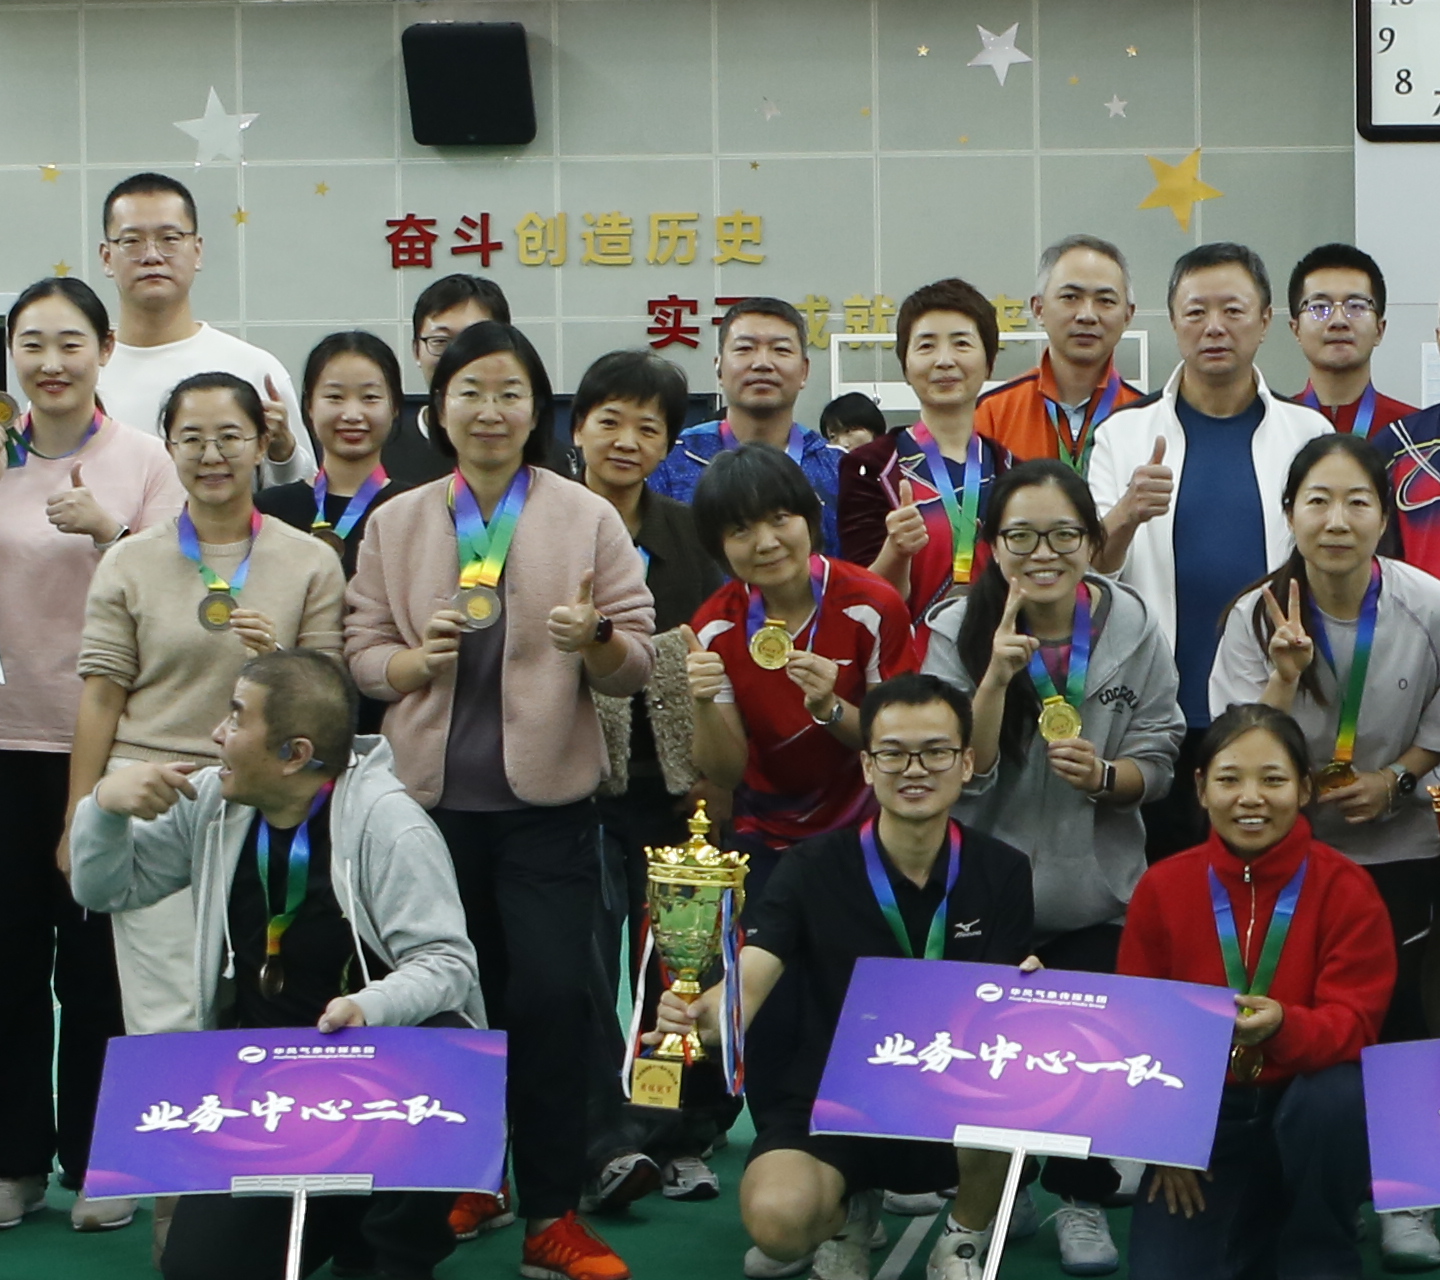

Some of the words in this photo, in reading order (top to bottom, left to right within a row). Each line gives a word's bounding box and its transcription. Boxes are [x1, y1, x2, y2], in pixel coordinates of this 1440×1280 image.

[1376, 27, 1396, 53] 9
[1395, 69, 1413, 95] 8
[386, 210, 765, 269] 奋斗创造历史
[867, 1032, 1185, 1090] 业务中心一队
[135, 1090, 467, 1134] 业务中心二队
